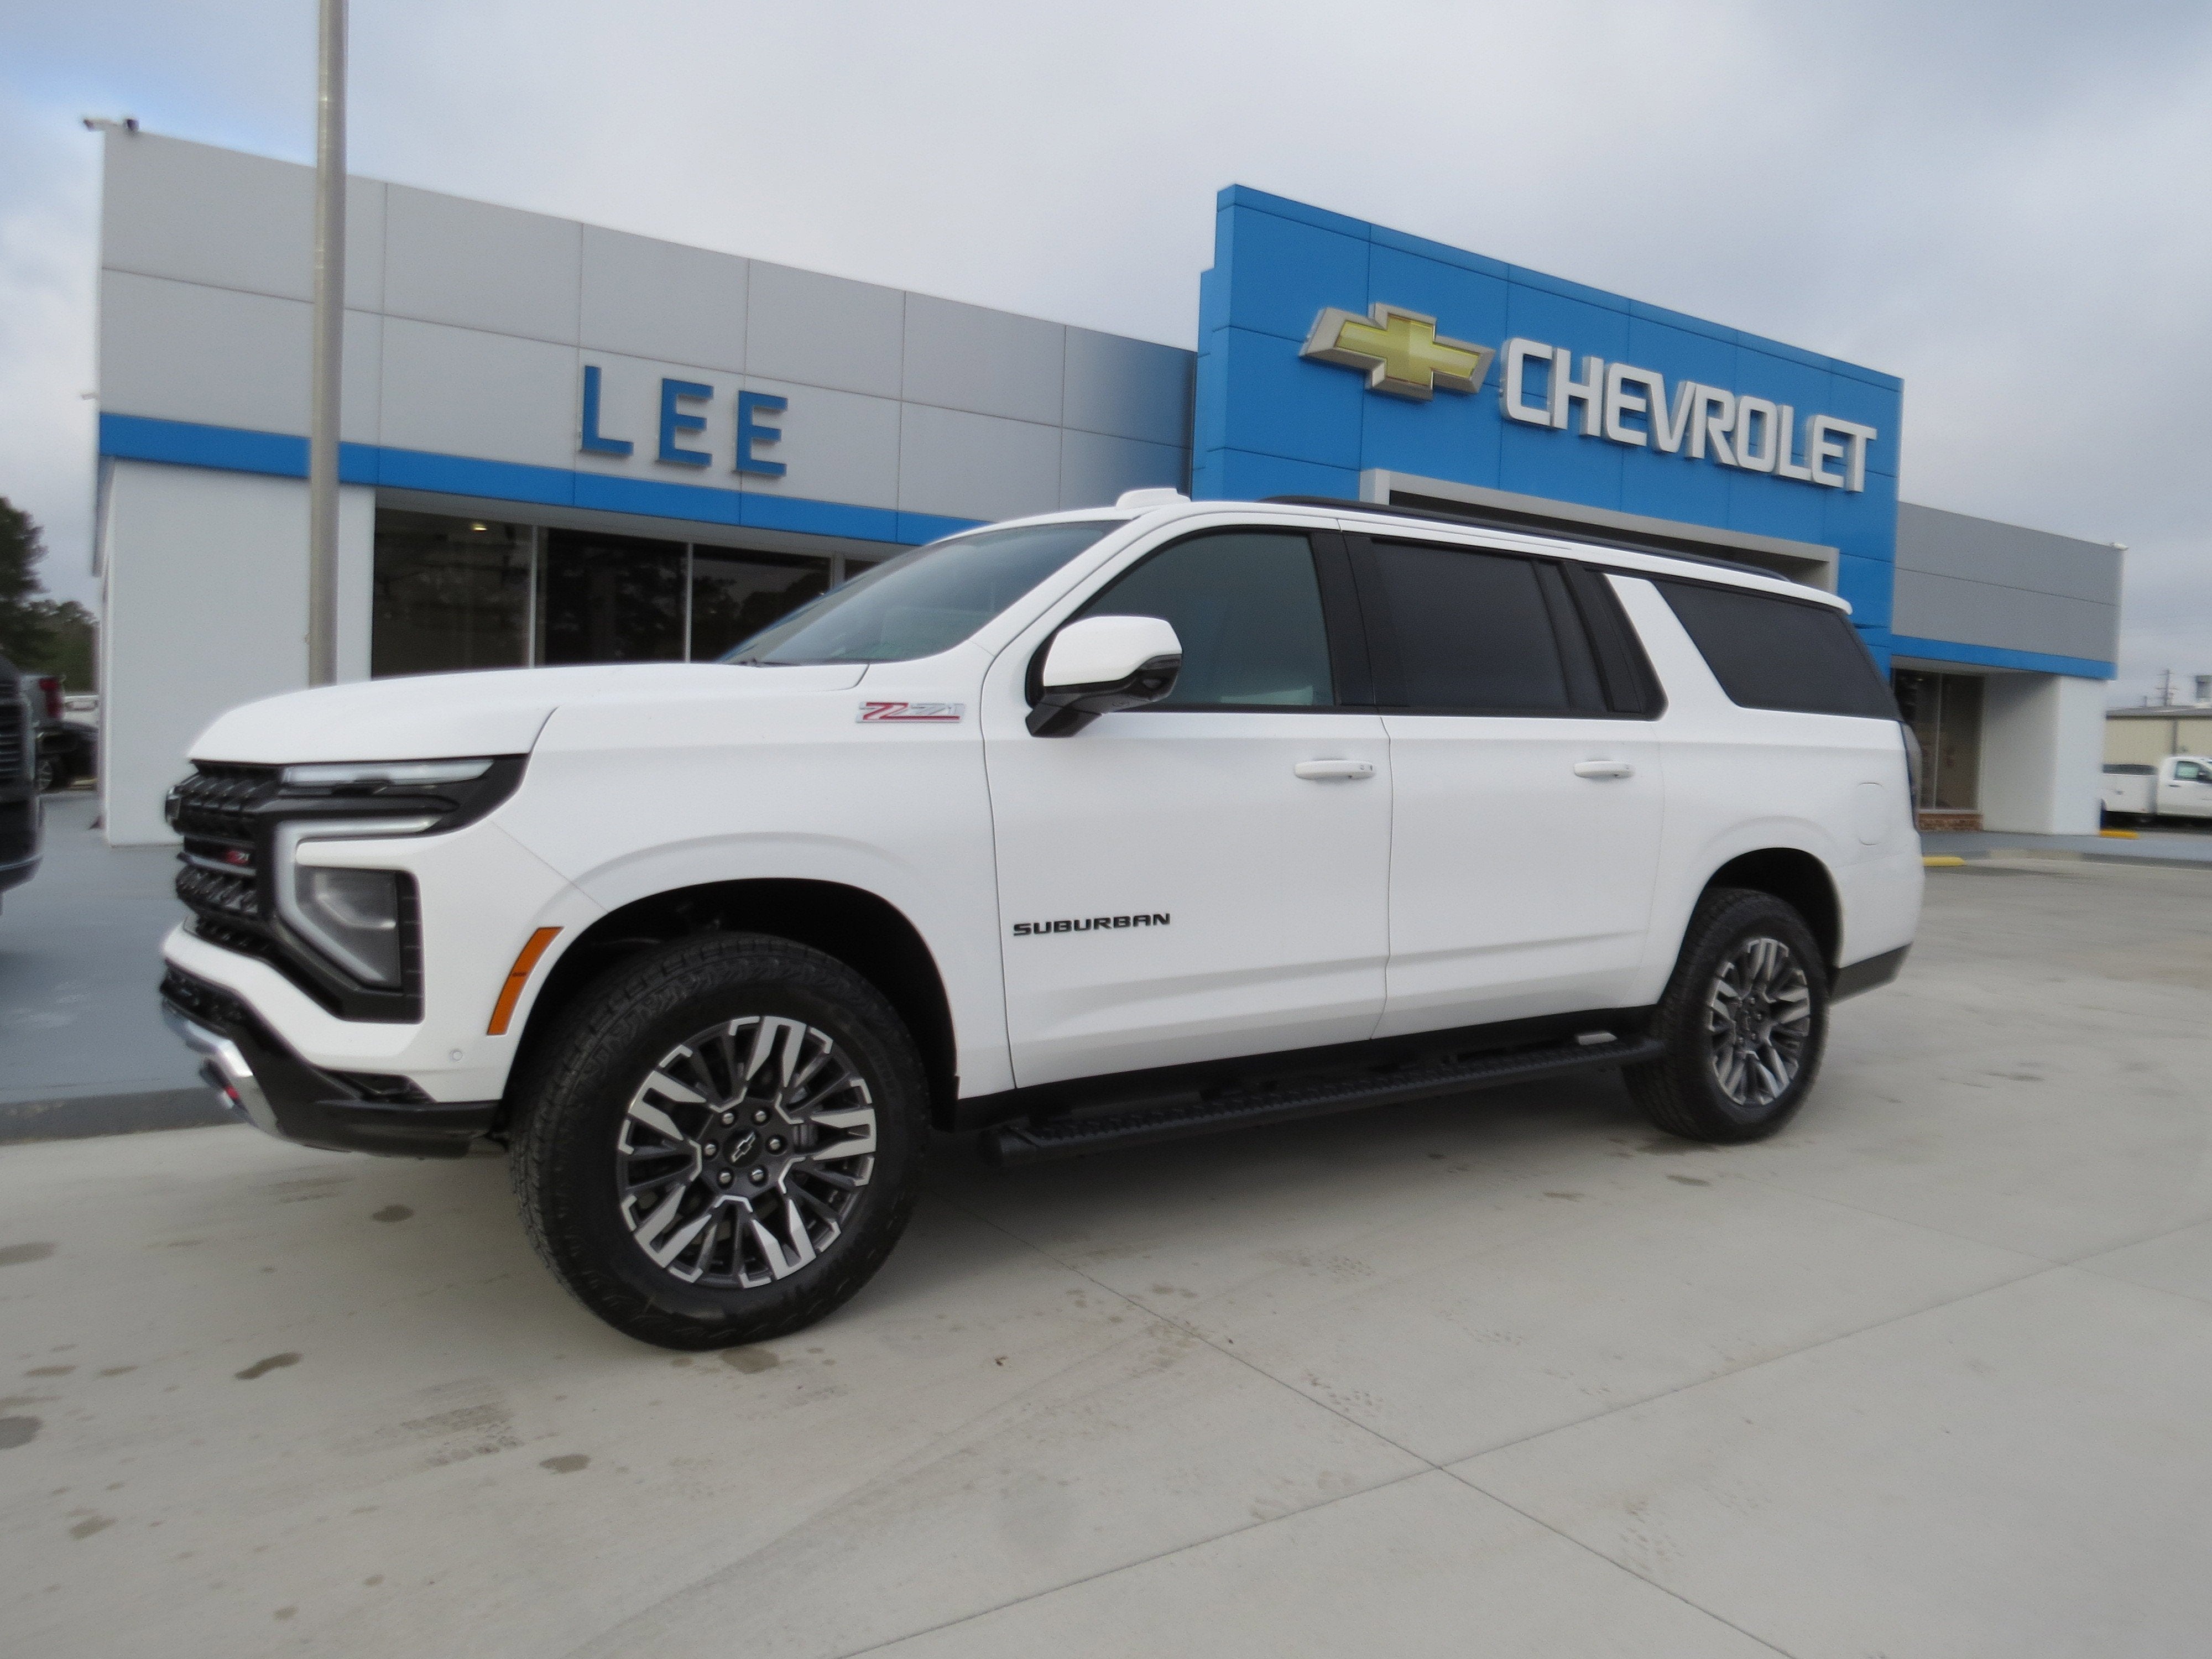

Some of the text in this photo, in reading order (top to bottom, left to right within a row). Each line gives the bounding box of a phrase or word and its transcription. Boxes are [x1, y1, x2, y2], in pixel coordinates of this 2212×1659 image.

[582, 365, 788, 476] LEE
[1500, 337, 1876, 492] CHEVROLET
[857, 702, 964, 723] Z71
[1013, 913, 1171, 936] SUBURBAN
